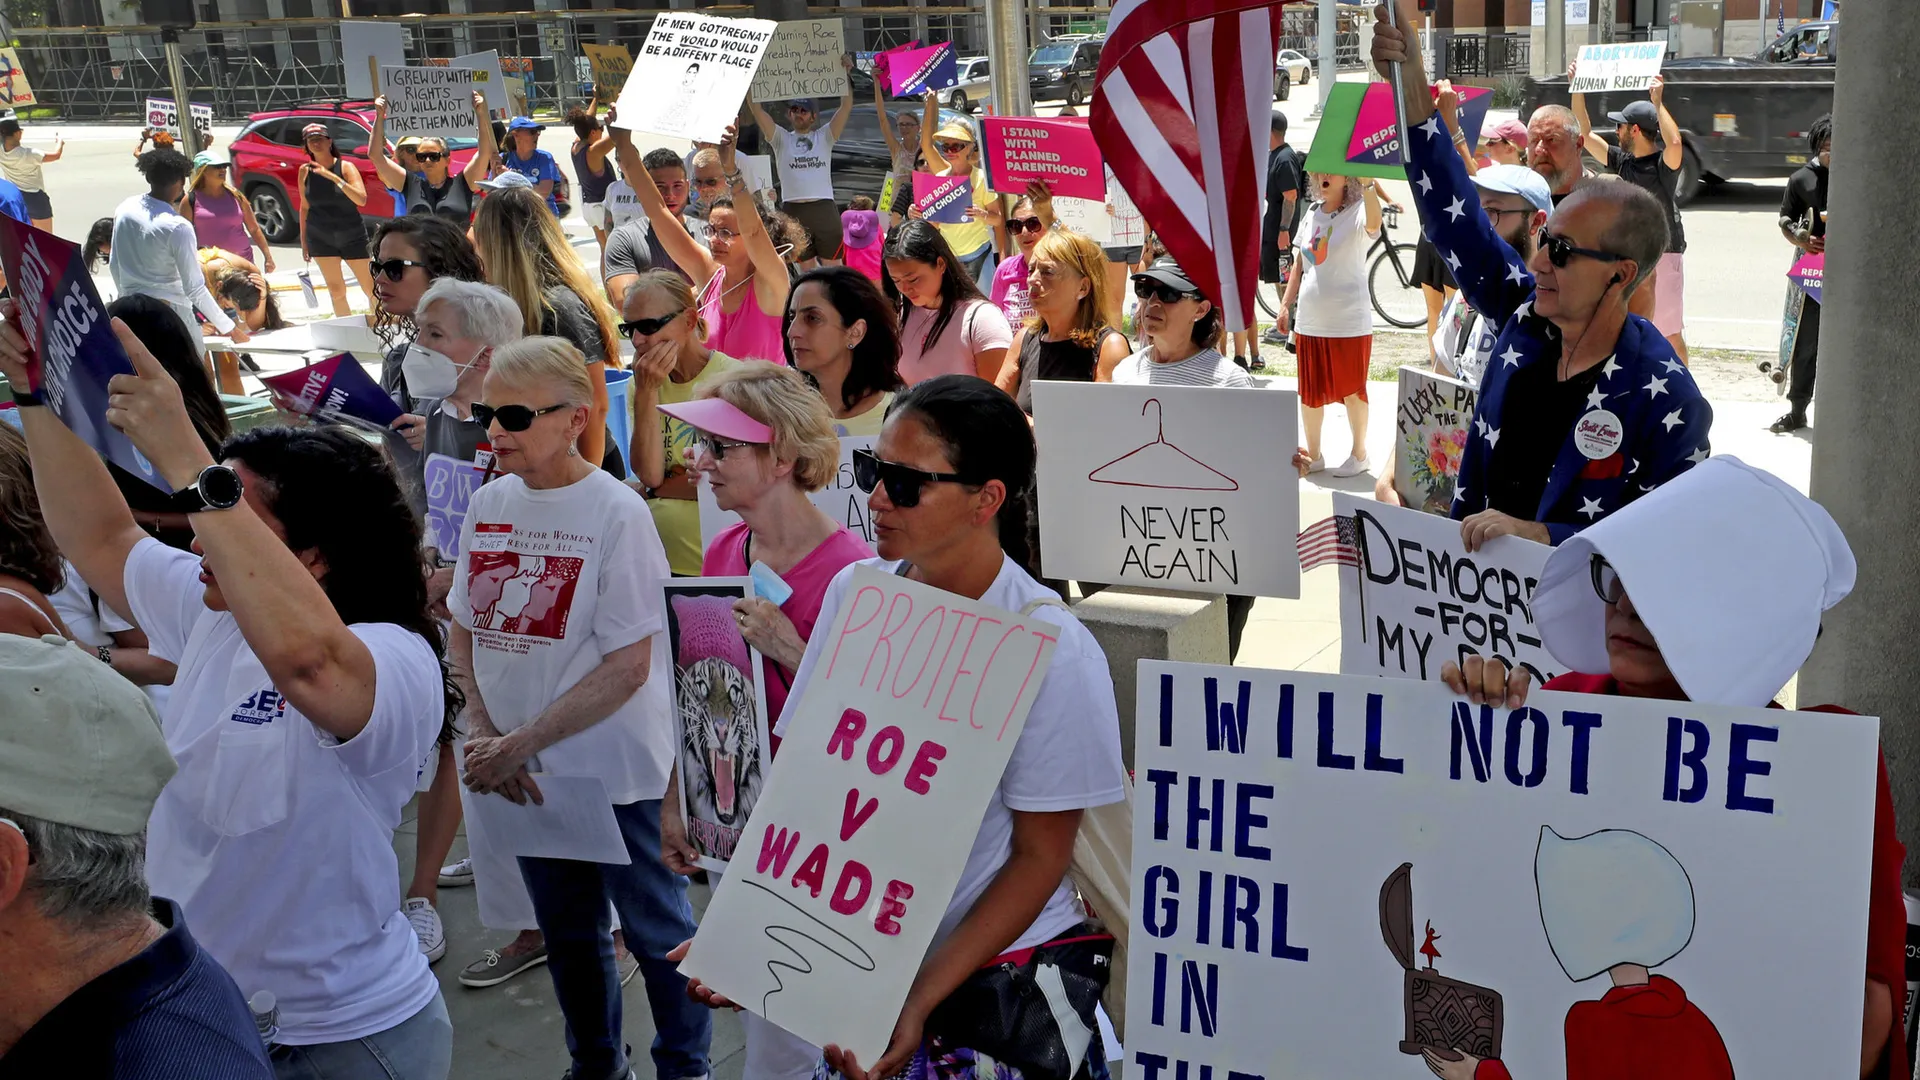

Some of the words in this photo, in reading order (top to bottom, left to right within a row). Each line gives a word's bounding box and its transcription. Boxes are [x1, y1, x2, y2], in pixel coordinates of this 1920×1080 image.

[657, 17, 669, 27] IF
[670, 20, 695, 30] MEN
[812, 23, 836, 38] Roe
[652, 31, 674, 42] THE
[680, 35, 718, 48] WORLD
[720, 40, 758, 54] WOULD
[1583, 44, 1660, 60] ABORTION
[646, 45, 661, 55] BE
[719, 54, 753, 69] PLACE
[924, 46, 945, 67] RIGHTS
[386, 69, 390, 86] I
[394, 70, 429, 86] GREW
[446, 69, 471, 84] WITH
[807, 61, 834, 76] Capitol
[915, 68, 933, 87] HUMAN
[405, 87, 451, 100] RIGHTS
[773, 81, 792, 97] ALL
[812, 77, 845, 94] COUP
[1573, 77, 1607, 91] HUMAN
[387, 99, 407, 114] YOU
[411, 100, 437, 113] WILL
[438, 98, 465, 112] NOT
[386, 116, 419, 131] TAKE
[418, 115, 449, 129] THEM
[451, 111, 475, 129] NOW
[1002, 127, 1007, 136] I
[1009, 128, 1048, 138] STAND
[1004, 139, 1036, 148] WITH
[808, 161, 826, 170] Right
[1005, 150, 1060, 162] PLANNED
[1006, 162, 1087, 177] PARENTHOOD
[920, 194, 934, 207] OUR
[933, 179, 954, 197] BODY
[922, 206, 936, 220] OUR
[935, 185, 967, 210] CHOICE
[19, 233, 51, 317] BODY
[48, 280, 98, 381] CHOICE
[1434, 413, 1458, 427] THE
[1120, 505, 1227, 542] NEVER
[528, 531, 547, 539] FOR
[553, 530, 594, 544] WOMEN
[533, 543, 550, 551] FOR
[555, 543, 573, 552] ALL
[1120, 543, 1238, 585] AGAIN
[516, 642, 530, 650] 1992
[519, 637, 552, 647] Conference
[1376, 614, 1433, 681] MY
[826, 585, 1058, 741] PROTECT
[827, 707, 948, 796] ROE
[1159, 674, 1173, 747] I
[1203, 677, 1404, 774] WILL
[1449, 701, 1602, 795] NOT
[1663, 717, 1779, 814] BE
[839, 788, 879, 842] V
[1147, 769, 1274, 861] THE
[755, 823, 914, 936] WADE
[1142, 865, 1309, 962] GIRL
[1151, 952, 1218, 1038] IN
